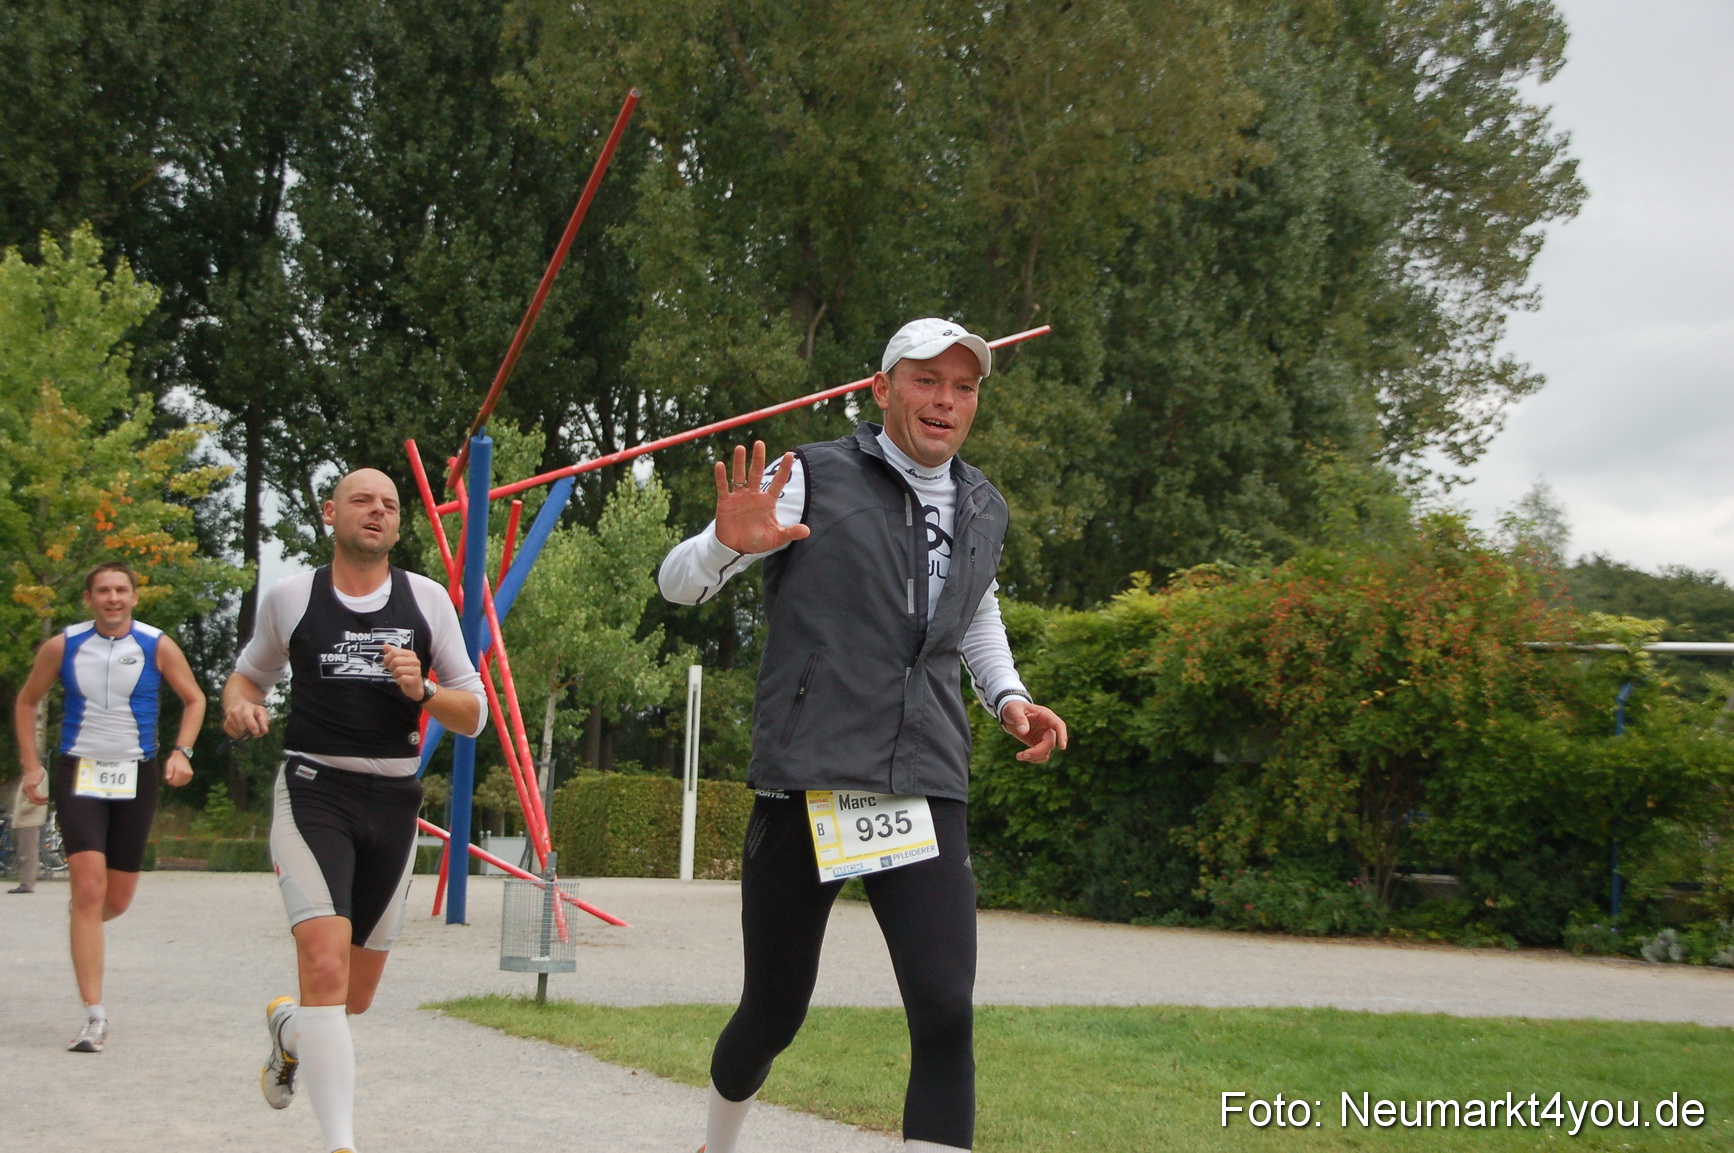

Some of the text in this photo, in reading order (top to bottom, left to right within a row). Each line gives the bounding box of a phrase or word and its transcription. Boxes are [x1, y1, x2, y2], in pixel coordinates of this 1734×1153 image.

[321, 653, 347, 662] ZONE
[100, 772, 126, 785] 610
[838, 794, 877, 811] Marc
[816, 823, 825, 836] B
[856, 810, 913, 842] 935
[893, 844, 936, 861] PFLEIDERER
